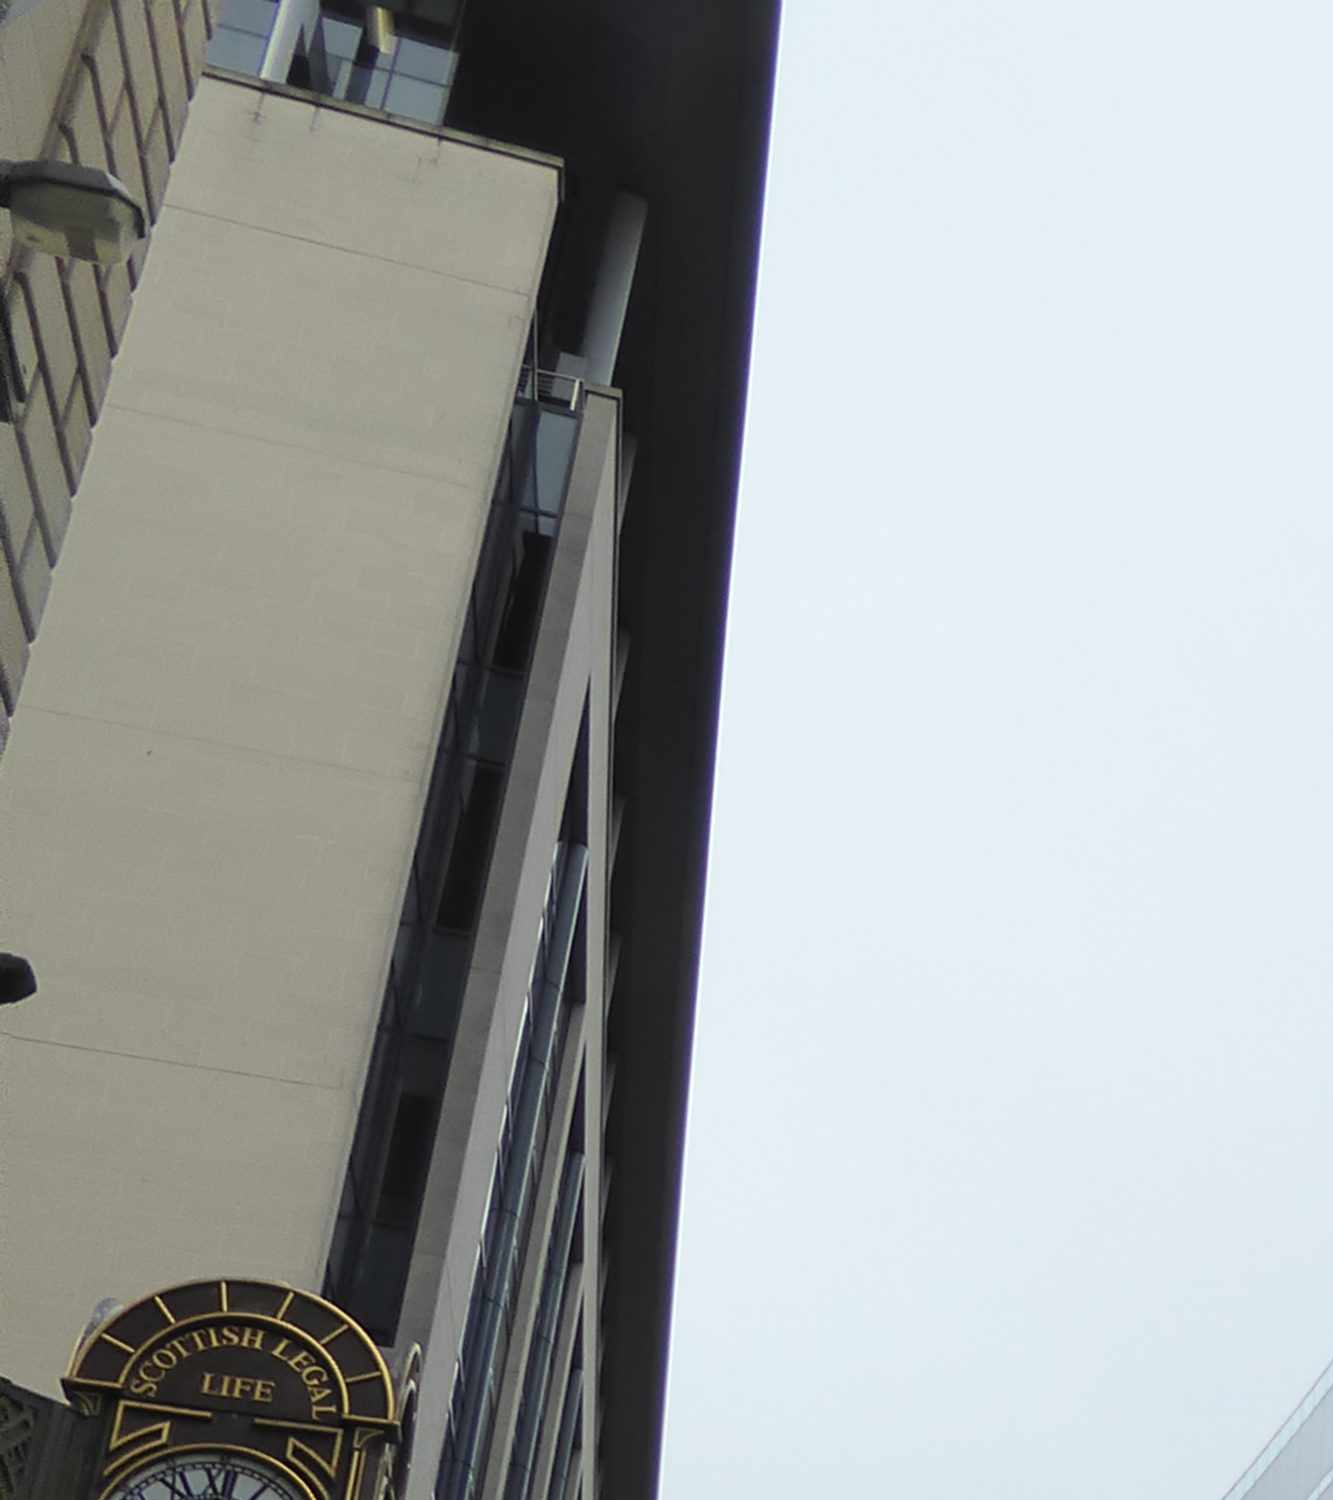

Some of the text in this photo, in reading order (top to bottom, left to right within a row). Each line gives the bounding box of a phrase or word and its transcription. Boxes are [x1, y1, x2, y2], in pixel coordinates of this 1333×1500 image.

[130, 1326, 338, 1421] SCOTTISH LEGAL
[200, 1372, 276, 1403] LIFE
